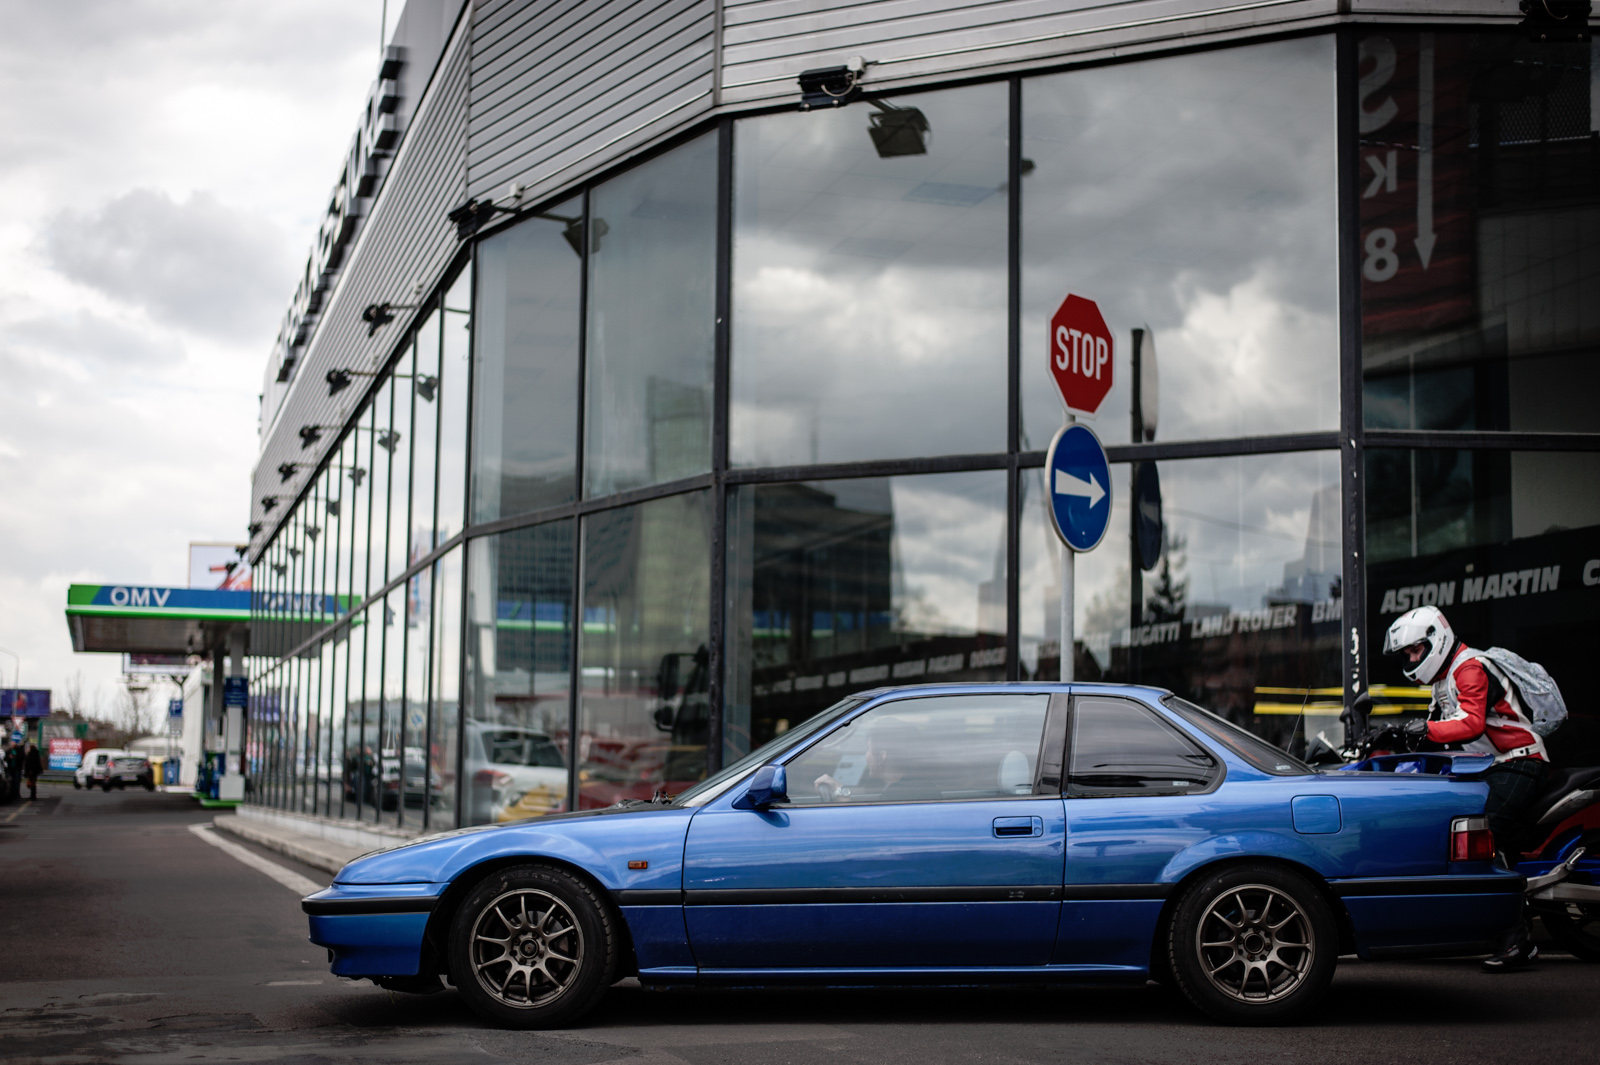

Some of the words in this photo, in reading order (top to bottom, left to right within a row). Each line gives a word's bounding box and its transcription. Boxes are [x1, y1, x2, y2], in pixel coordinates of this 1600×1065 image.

[1055, 324, 1109, 381] STOP
[110, 586, 171, 607] OMV
[1380, 580, 1456, 614] ASTON
[1461, 565, 1561, 604] MARTIN
[1582, 559, 1600, 586] C
[1121, 621, 1181, 648] BUGATTI
[1190, 613, 1236, 640] LAND
[1238, 604, 1298, 634] ROVER
[1311, 597, 1343, 624] BM
